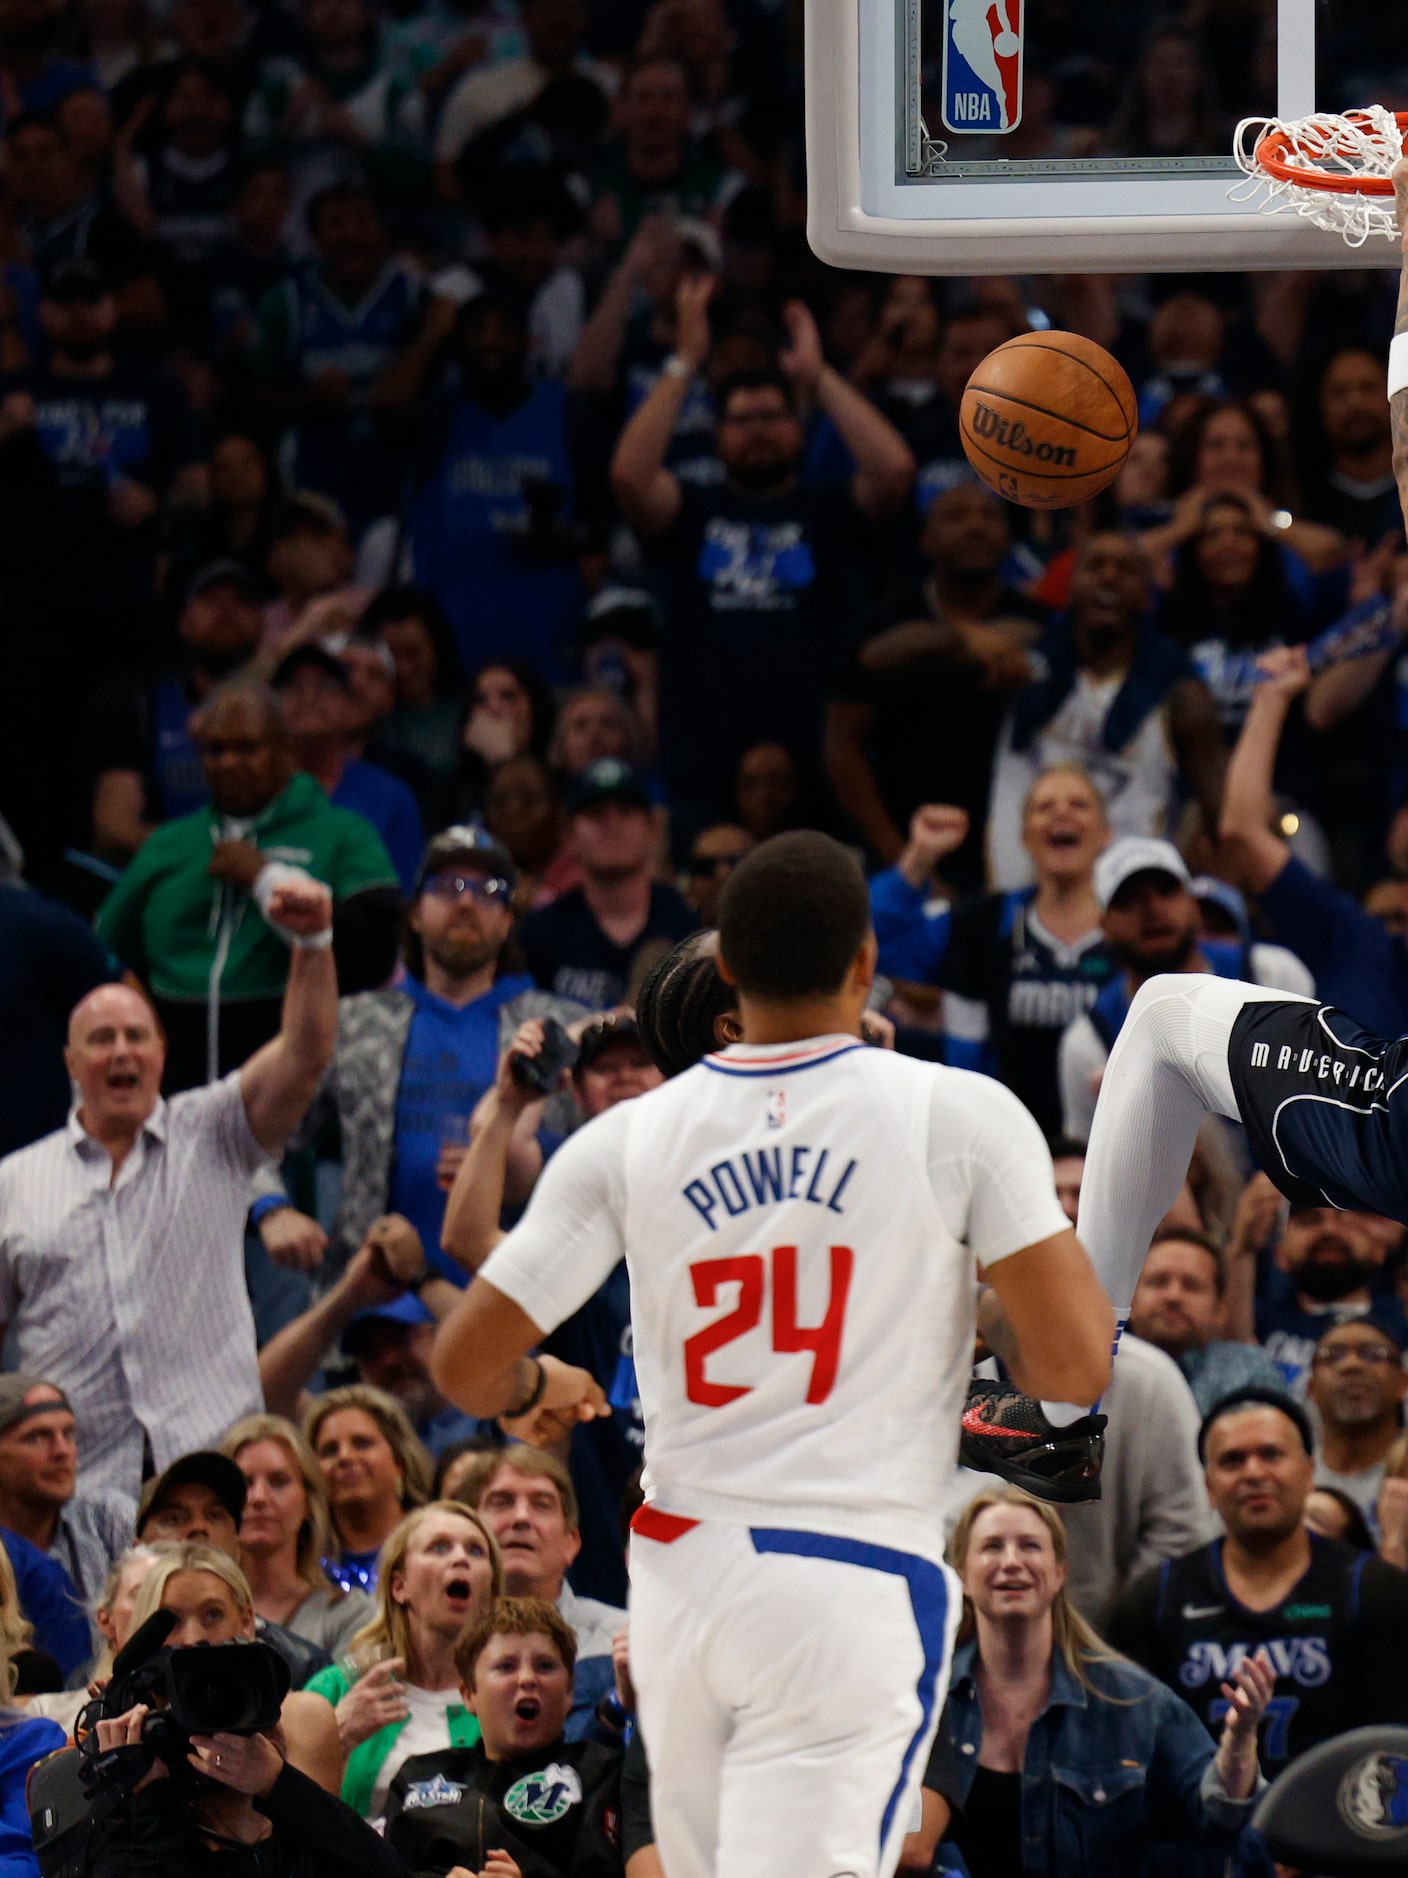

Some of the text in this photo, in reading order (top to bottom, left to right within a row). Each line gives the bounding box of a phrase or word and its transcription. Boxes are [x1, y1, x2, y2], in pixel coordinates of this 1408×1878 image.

[954, 92, 991, 121] NBA
[972, 400, 1077, 467] Wilson
[682, 1146, 858, 1232] POWELL
[683, 1245, 855, 1409] 24
[1178, 1635, 1333, 1688] MAVS
